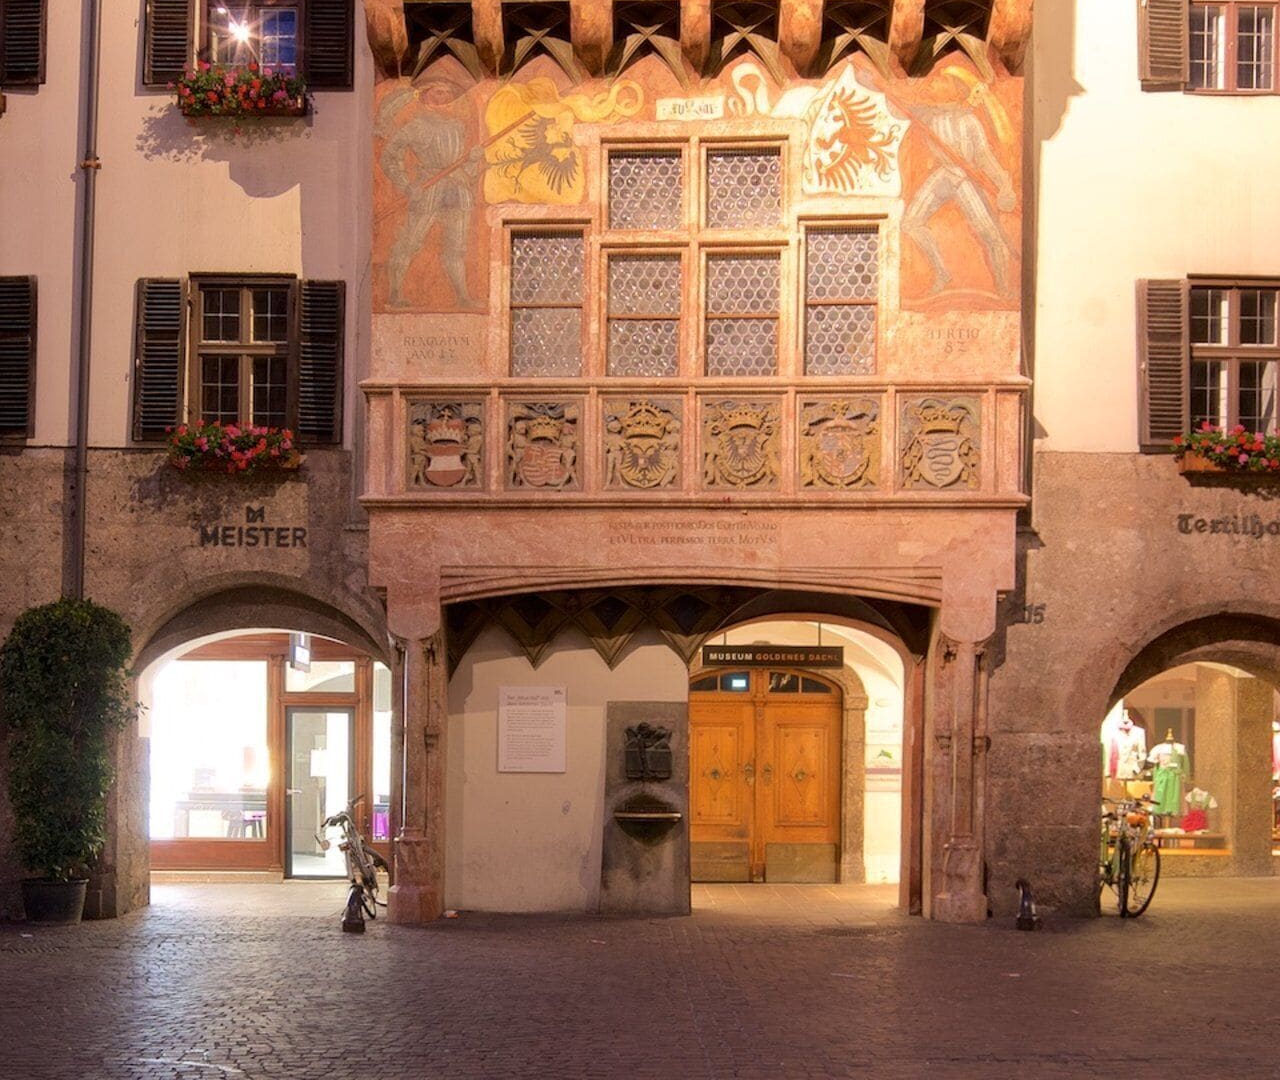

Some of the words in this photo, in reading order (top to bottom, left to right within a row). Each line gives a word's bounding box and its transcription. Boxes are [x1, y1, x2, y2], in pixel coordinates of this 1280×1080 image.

[200, 525, 308, 548] MEISTER
[709, 652, 753, 661] MUSEUM
[755, 653, 805, 661] GOLDENES
